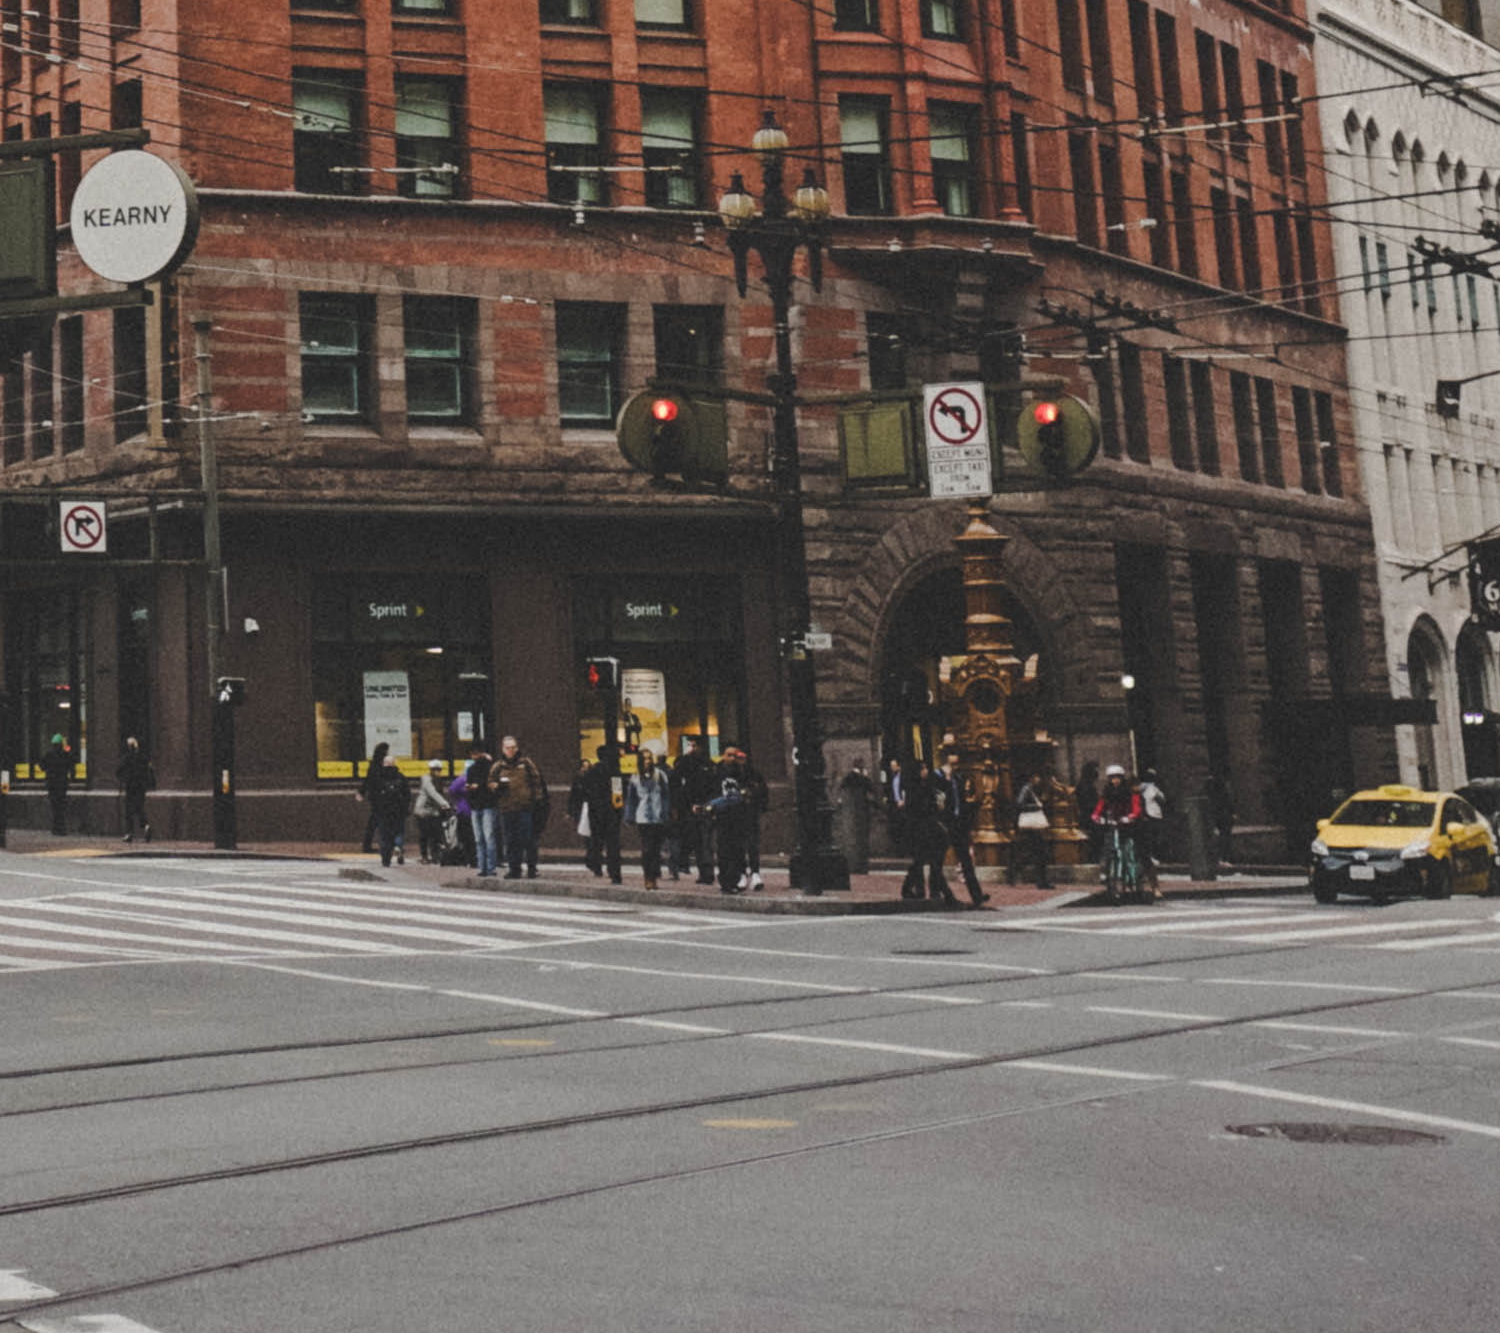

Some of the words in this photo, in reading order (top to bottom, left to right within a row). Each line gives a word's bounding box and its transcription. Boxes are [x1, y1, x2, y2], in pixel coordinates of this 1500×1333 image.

[84, 204, 172, 228] KEARNY
[368, 602, 408, 621] Sprint
[625, 602, 663, 620] Sprint
